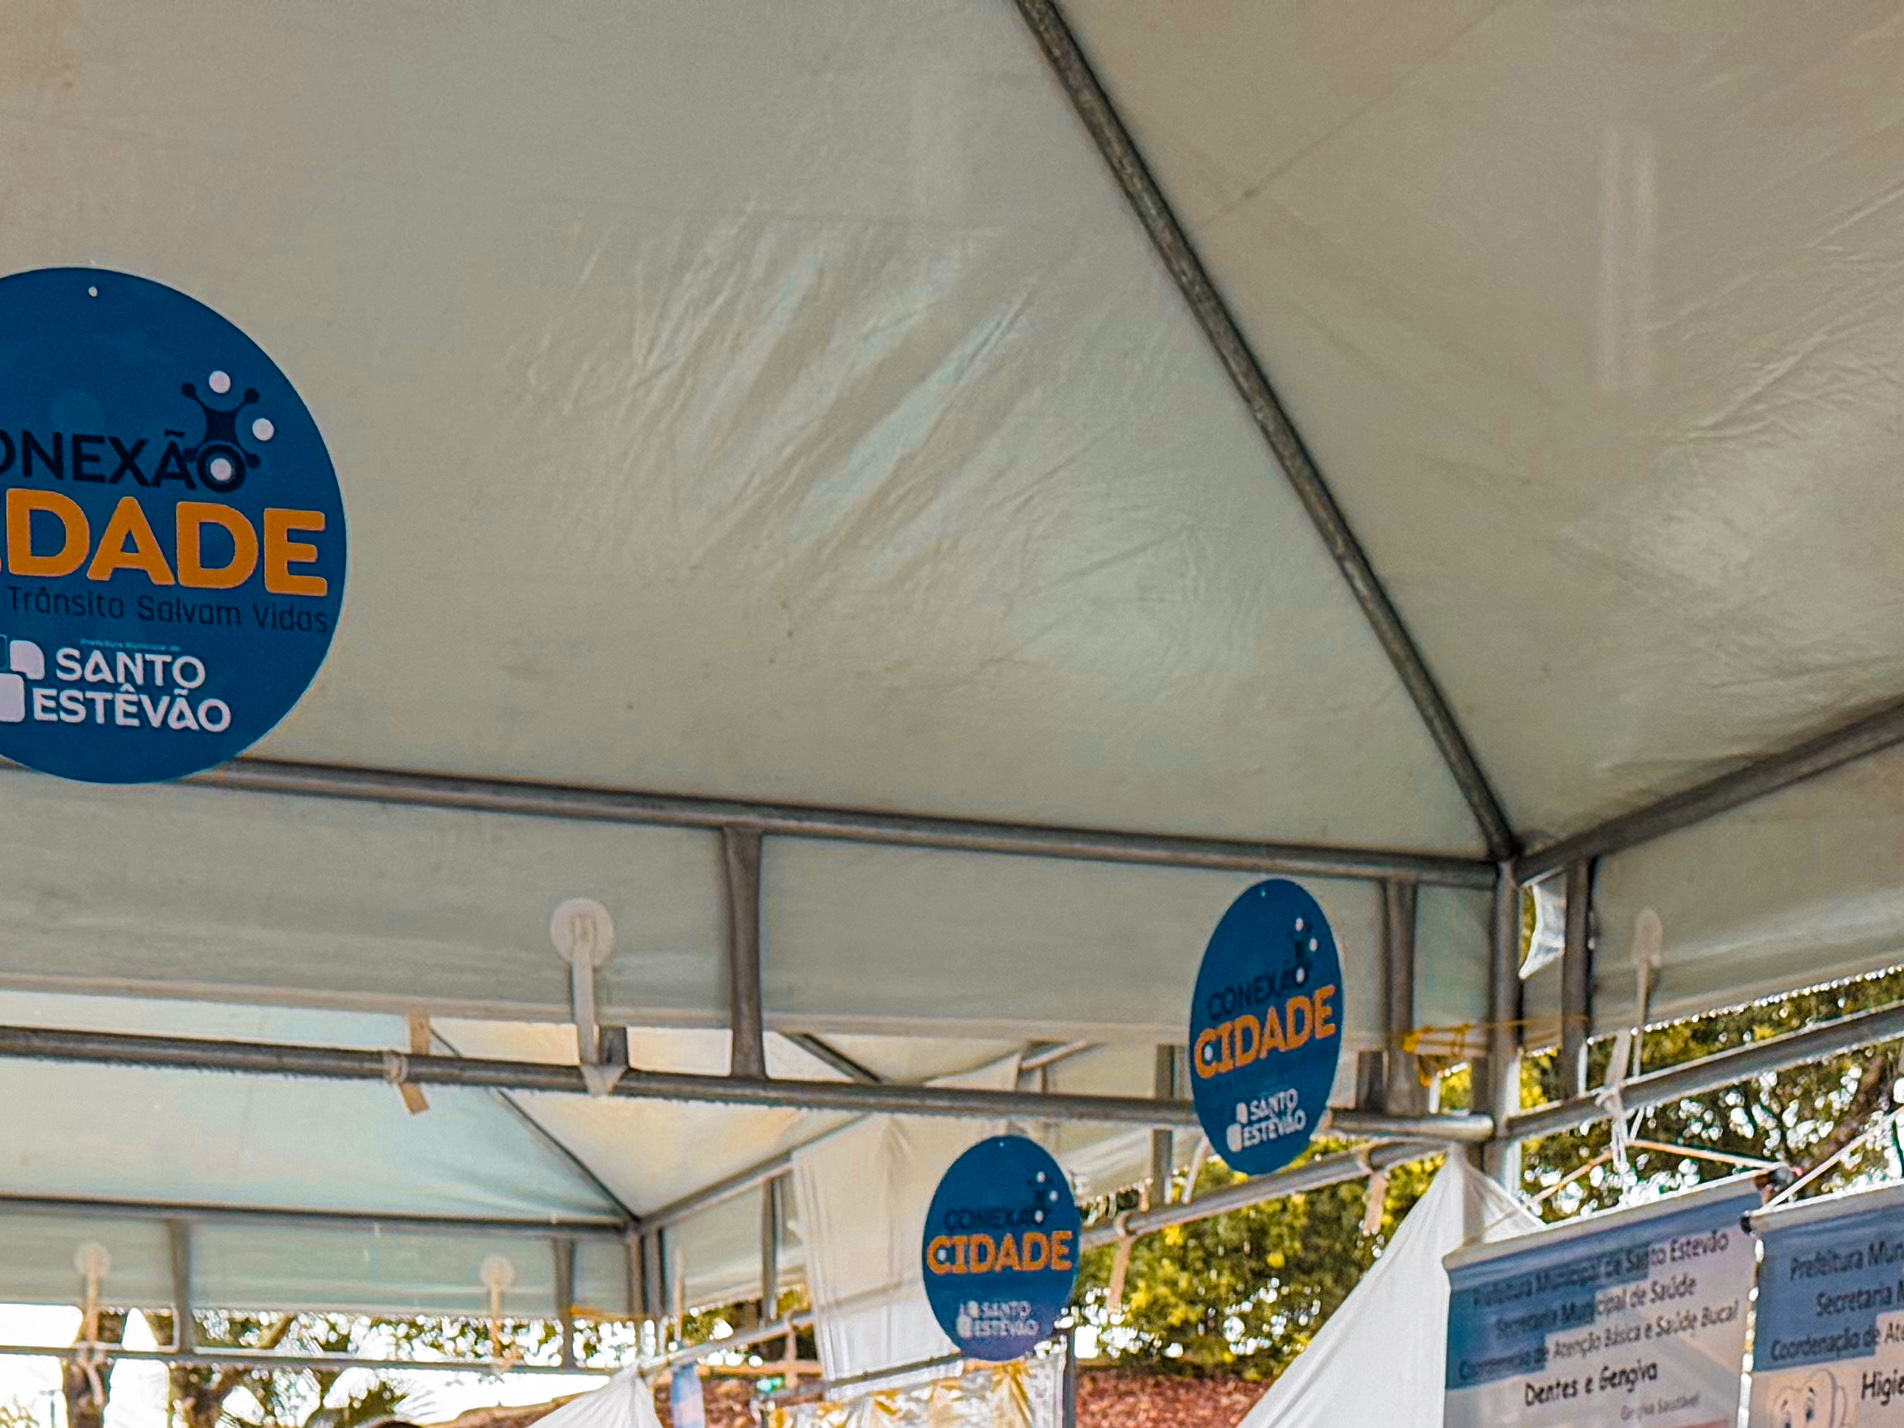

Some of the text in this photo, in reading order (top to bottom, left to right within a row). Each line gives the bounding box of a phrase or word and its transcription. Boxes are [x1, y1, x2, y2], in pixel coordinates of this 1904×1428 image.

[9, 585, 124, 620] Trânsito
[137, 597, 240, 629] Salvam
[253, 604, 328, 634] Vidas
[56, 647, 205, 690] SANTO
[33, 682, 232, 732] ESTÊVÃO
[1195, 984, 1336, 1079] CIDADE
[927, 1231, 1073, 1274] CIDADE
[1525, 1378, 1577, 1407] Dentes
[1585, 1376, 1594, 1395] e
